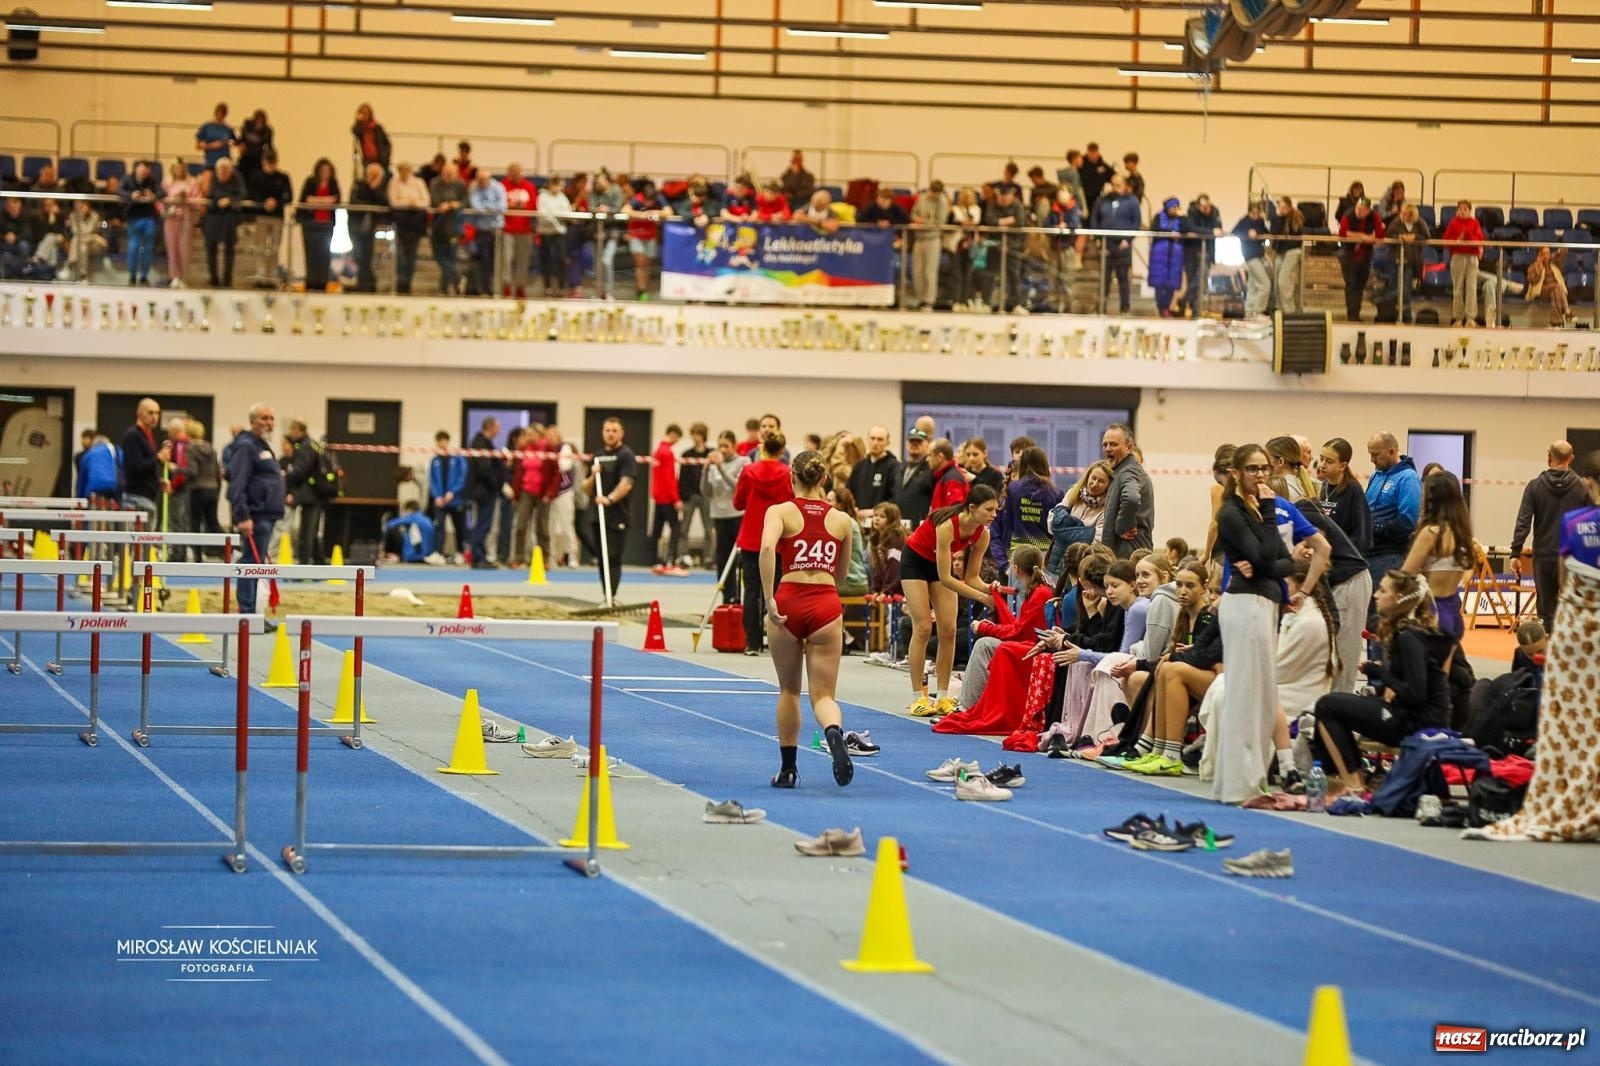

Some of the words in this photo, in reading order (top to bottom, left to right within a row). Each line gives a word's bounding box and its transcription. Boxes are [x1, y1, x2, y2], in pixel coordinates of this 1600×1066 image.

[763, 236, 864, 255] Lekkoatletyka
[793, 539, 837, 564] 249
[244, 566, 279, 576] polanik
[79, 616, 128, 630] polanik
[438, 623, 486, 636] polanik
